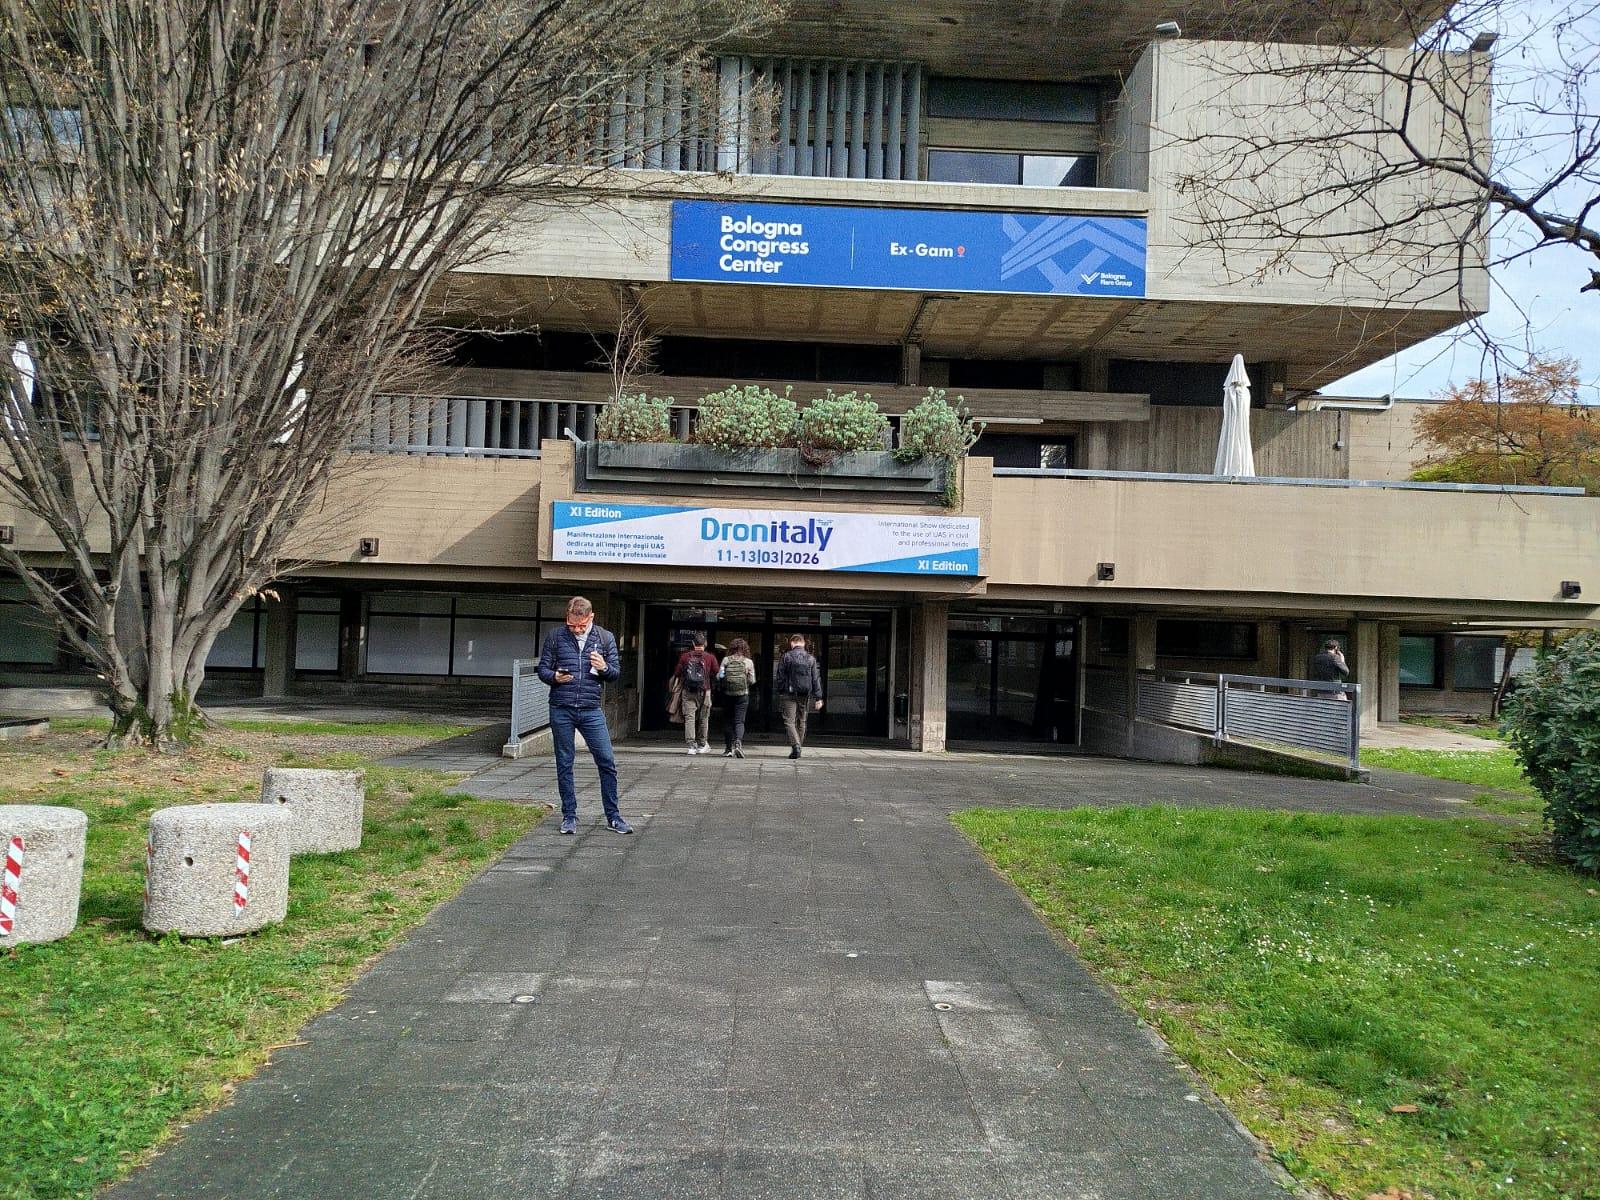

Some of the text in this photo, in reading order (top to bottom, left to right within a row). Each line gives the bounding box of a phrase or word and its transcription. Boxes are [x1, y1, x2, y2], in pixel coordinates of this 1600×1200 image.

[721, 215, 802, 240] Bologna
[720, 234, 810, 257] Congress
[719, 254, 783, 273] Center
[1100, 272, 1126, 280] Bologna
[570, 506, 622, 519] XI Edition
[566, 531, 665, 540] Manifestazione internazionale
[701, 517, 833, 552] Dronitaly
[632, 542, 649, 550] degli
[918, 560, 969, 572] XI Edition
